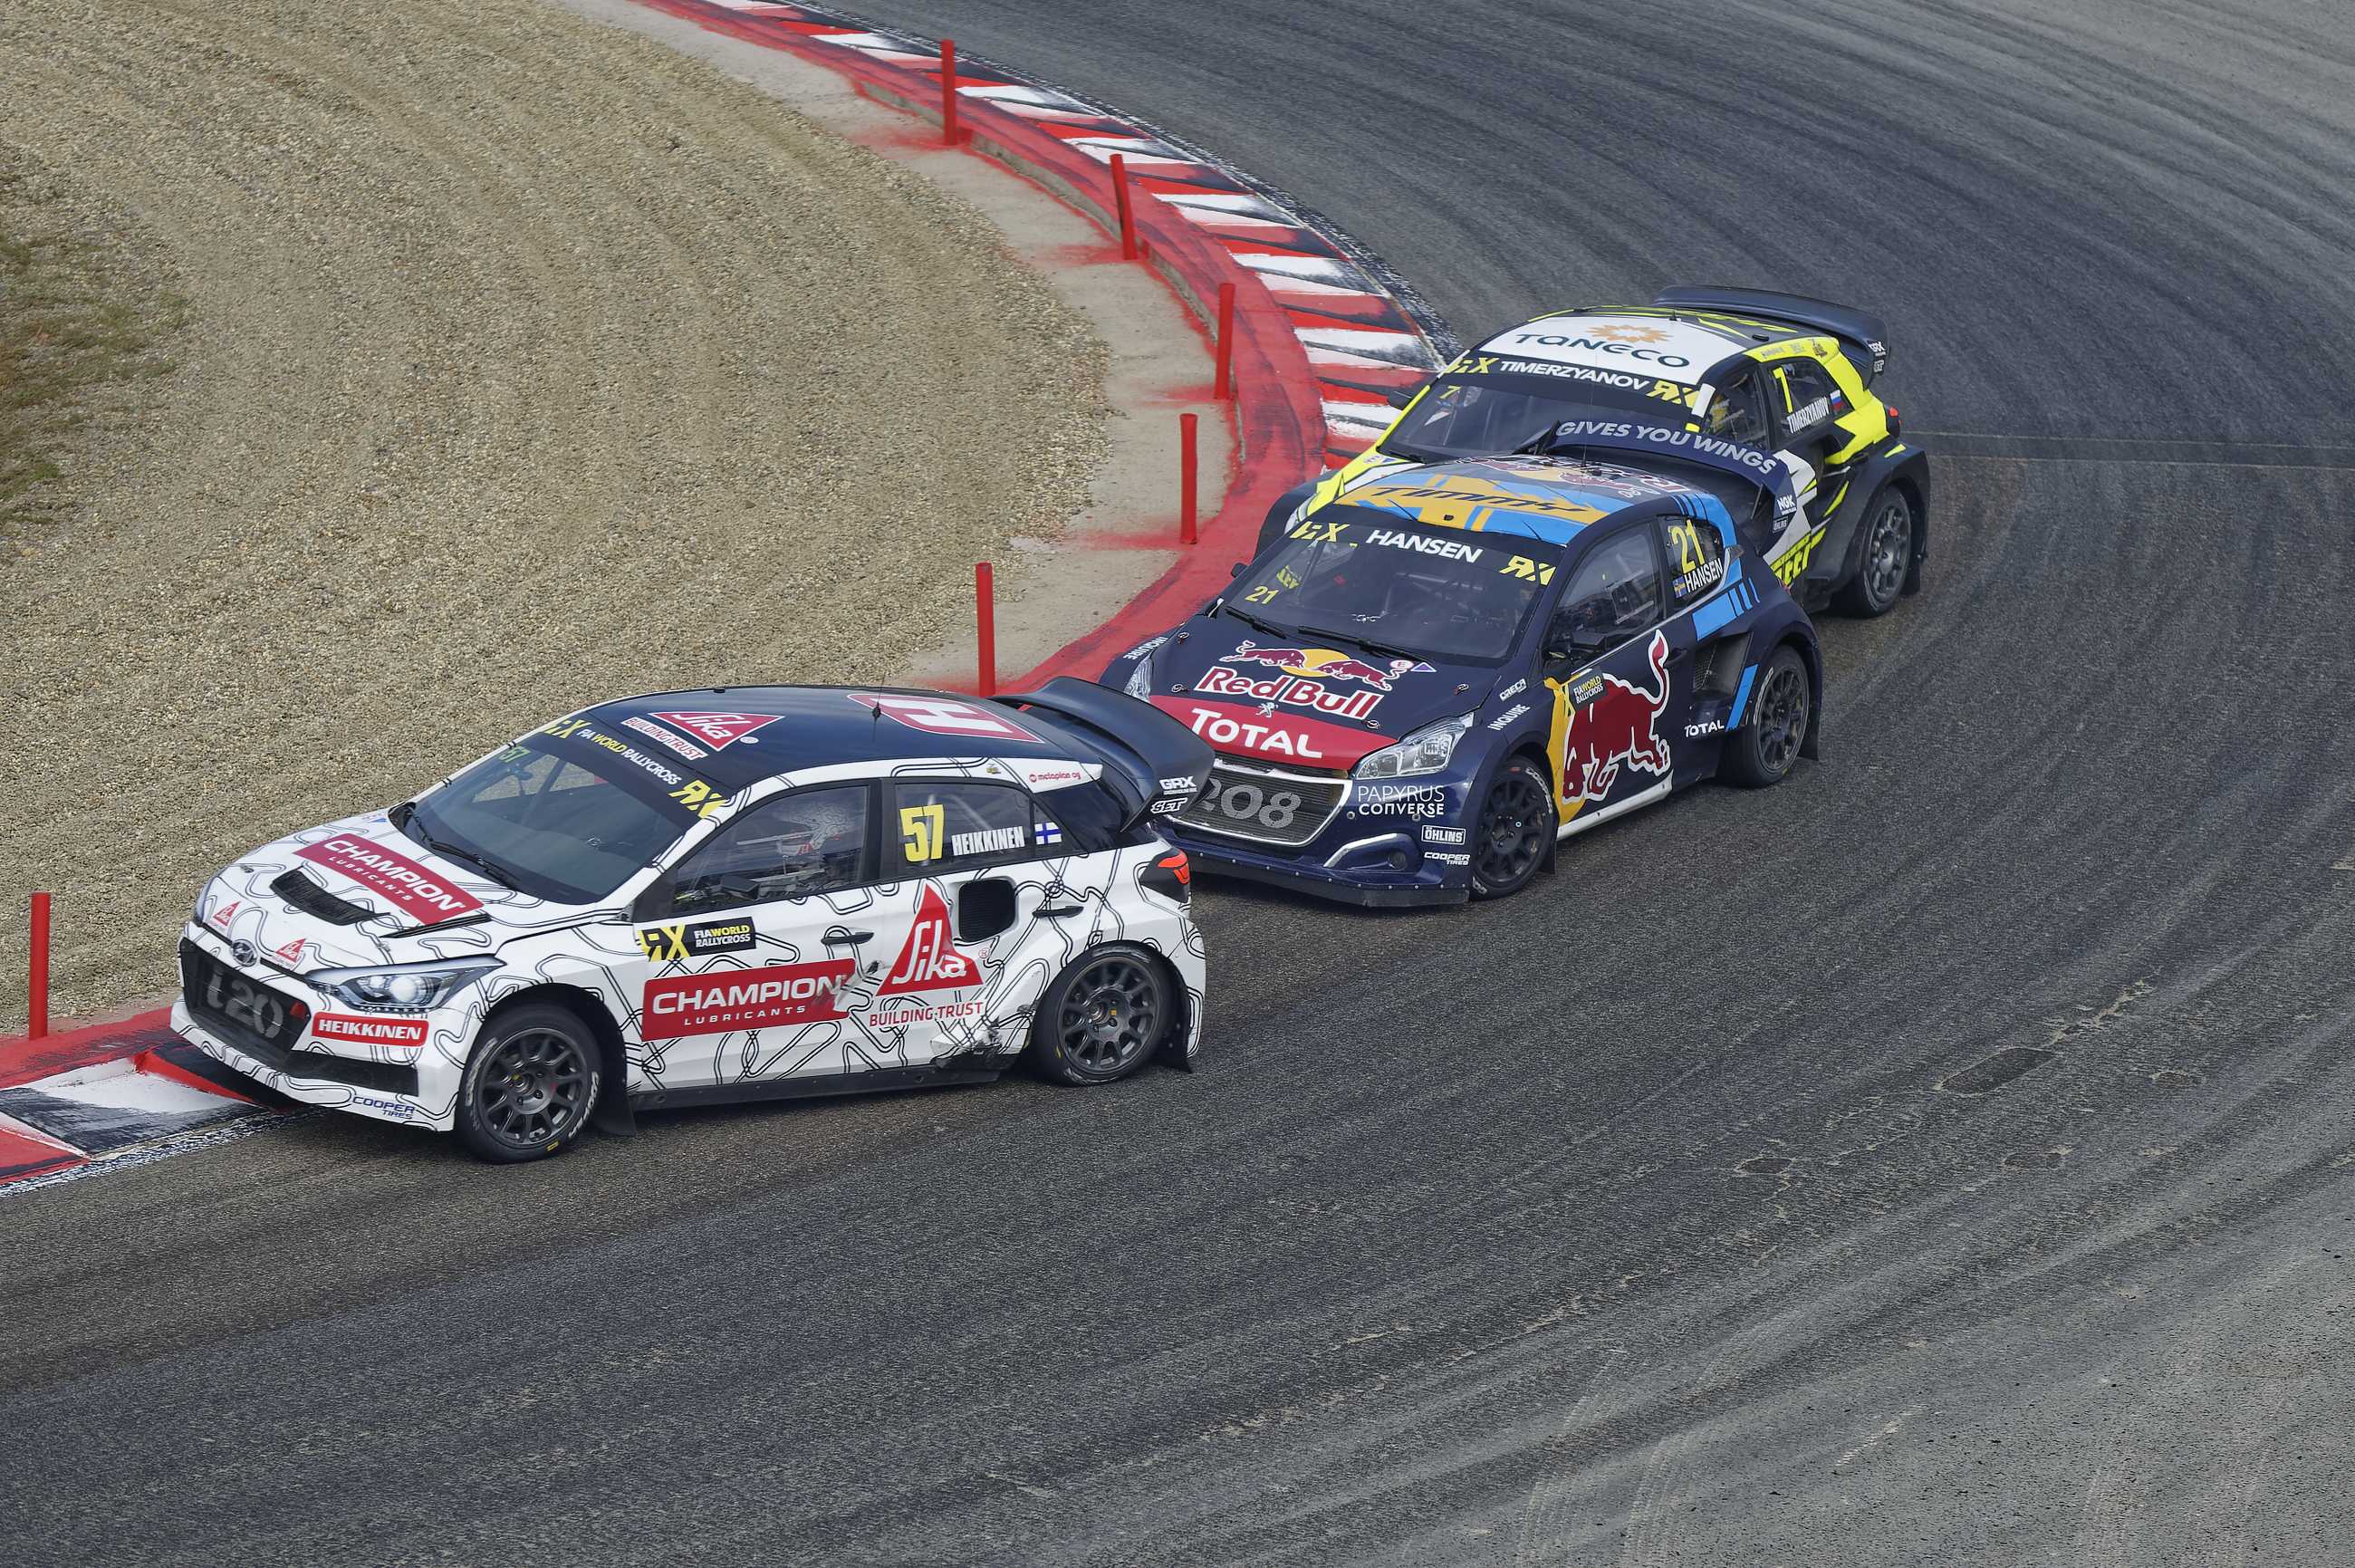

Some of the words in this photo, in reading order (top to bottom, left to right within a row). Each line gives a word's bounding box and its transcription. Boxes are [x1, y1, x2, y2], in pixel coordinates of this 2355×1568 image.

[1500, 361, 1650, 390] TIMERZYANOV
[1439, 385, 1461, 399] 7
[1556, 421, 1630, 437] GIVES
[1637, 425, 1692, 446] YOU
[1693, 435, 1777, 474] WINGS
[1776, 495, 1795, 510] NGK
[1366, 529, 1484, 563] HANSEN
[1671, 519, 1705, 574] 21
[1685, 557, 1724, 593] HANSEN
[1245, 585, 1279, 604] 21
[1194, 666, 1287, 702] Red
[1278, 678, 1385, 720] Bull
[671, 713, 753, 740] Sika
[1487, 704, 1531, 731] INQUIRE
[1684, 719, 1725, 738] TOTAL
[625, 717, 671, 745] BUILDING
[668, 737, 705, 760] TRUST
[1191, 707, 1322, 759] TOTAL
[593, 734, 628, 754] WORLD
[621, 748, 682, 785] RALLYCROSS
[1158, 776, 1197, 790] GRX
[1358, 784, 1446, 803] PAPYRUS
[899, 803, 945, 863] 57
[951, 826, 1025, 856] HEIKKINEN
[1425, 826, 1464, 843] ÖHLINS
[1424, 851, 1470, 861] COOPER
[322, 840, 467, 912] CHAMPION
[329, 856, 414, 901] LUBRICANTS
[695, 933, 752, 948] RALLYCROSS
[889, 919, 966, 986] Sika
[653, 974, 848, 1015] CHAMPION
[685, 1005, 806, 1026] LUBRICANTS
[870, 1008, 935, 1028] BUILDING
[937, 1001, 985, 1020] TRUST
[319, 1019, 422, 1041] HEIKKINEN
[352, 1095, 417, 1114] COOPER
[382, 1108, 414, 1121] TIRES
